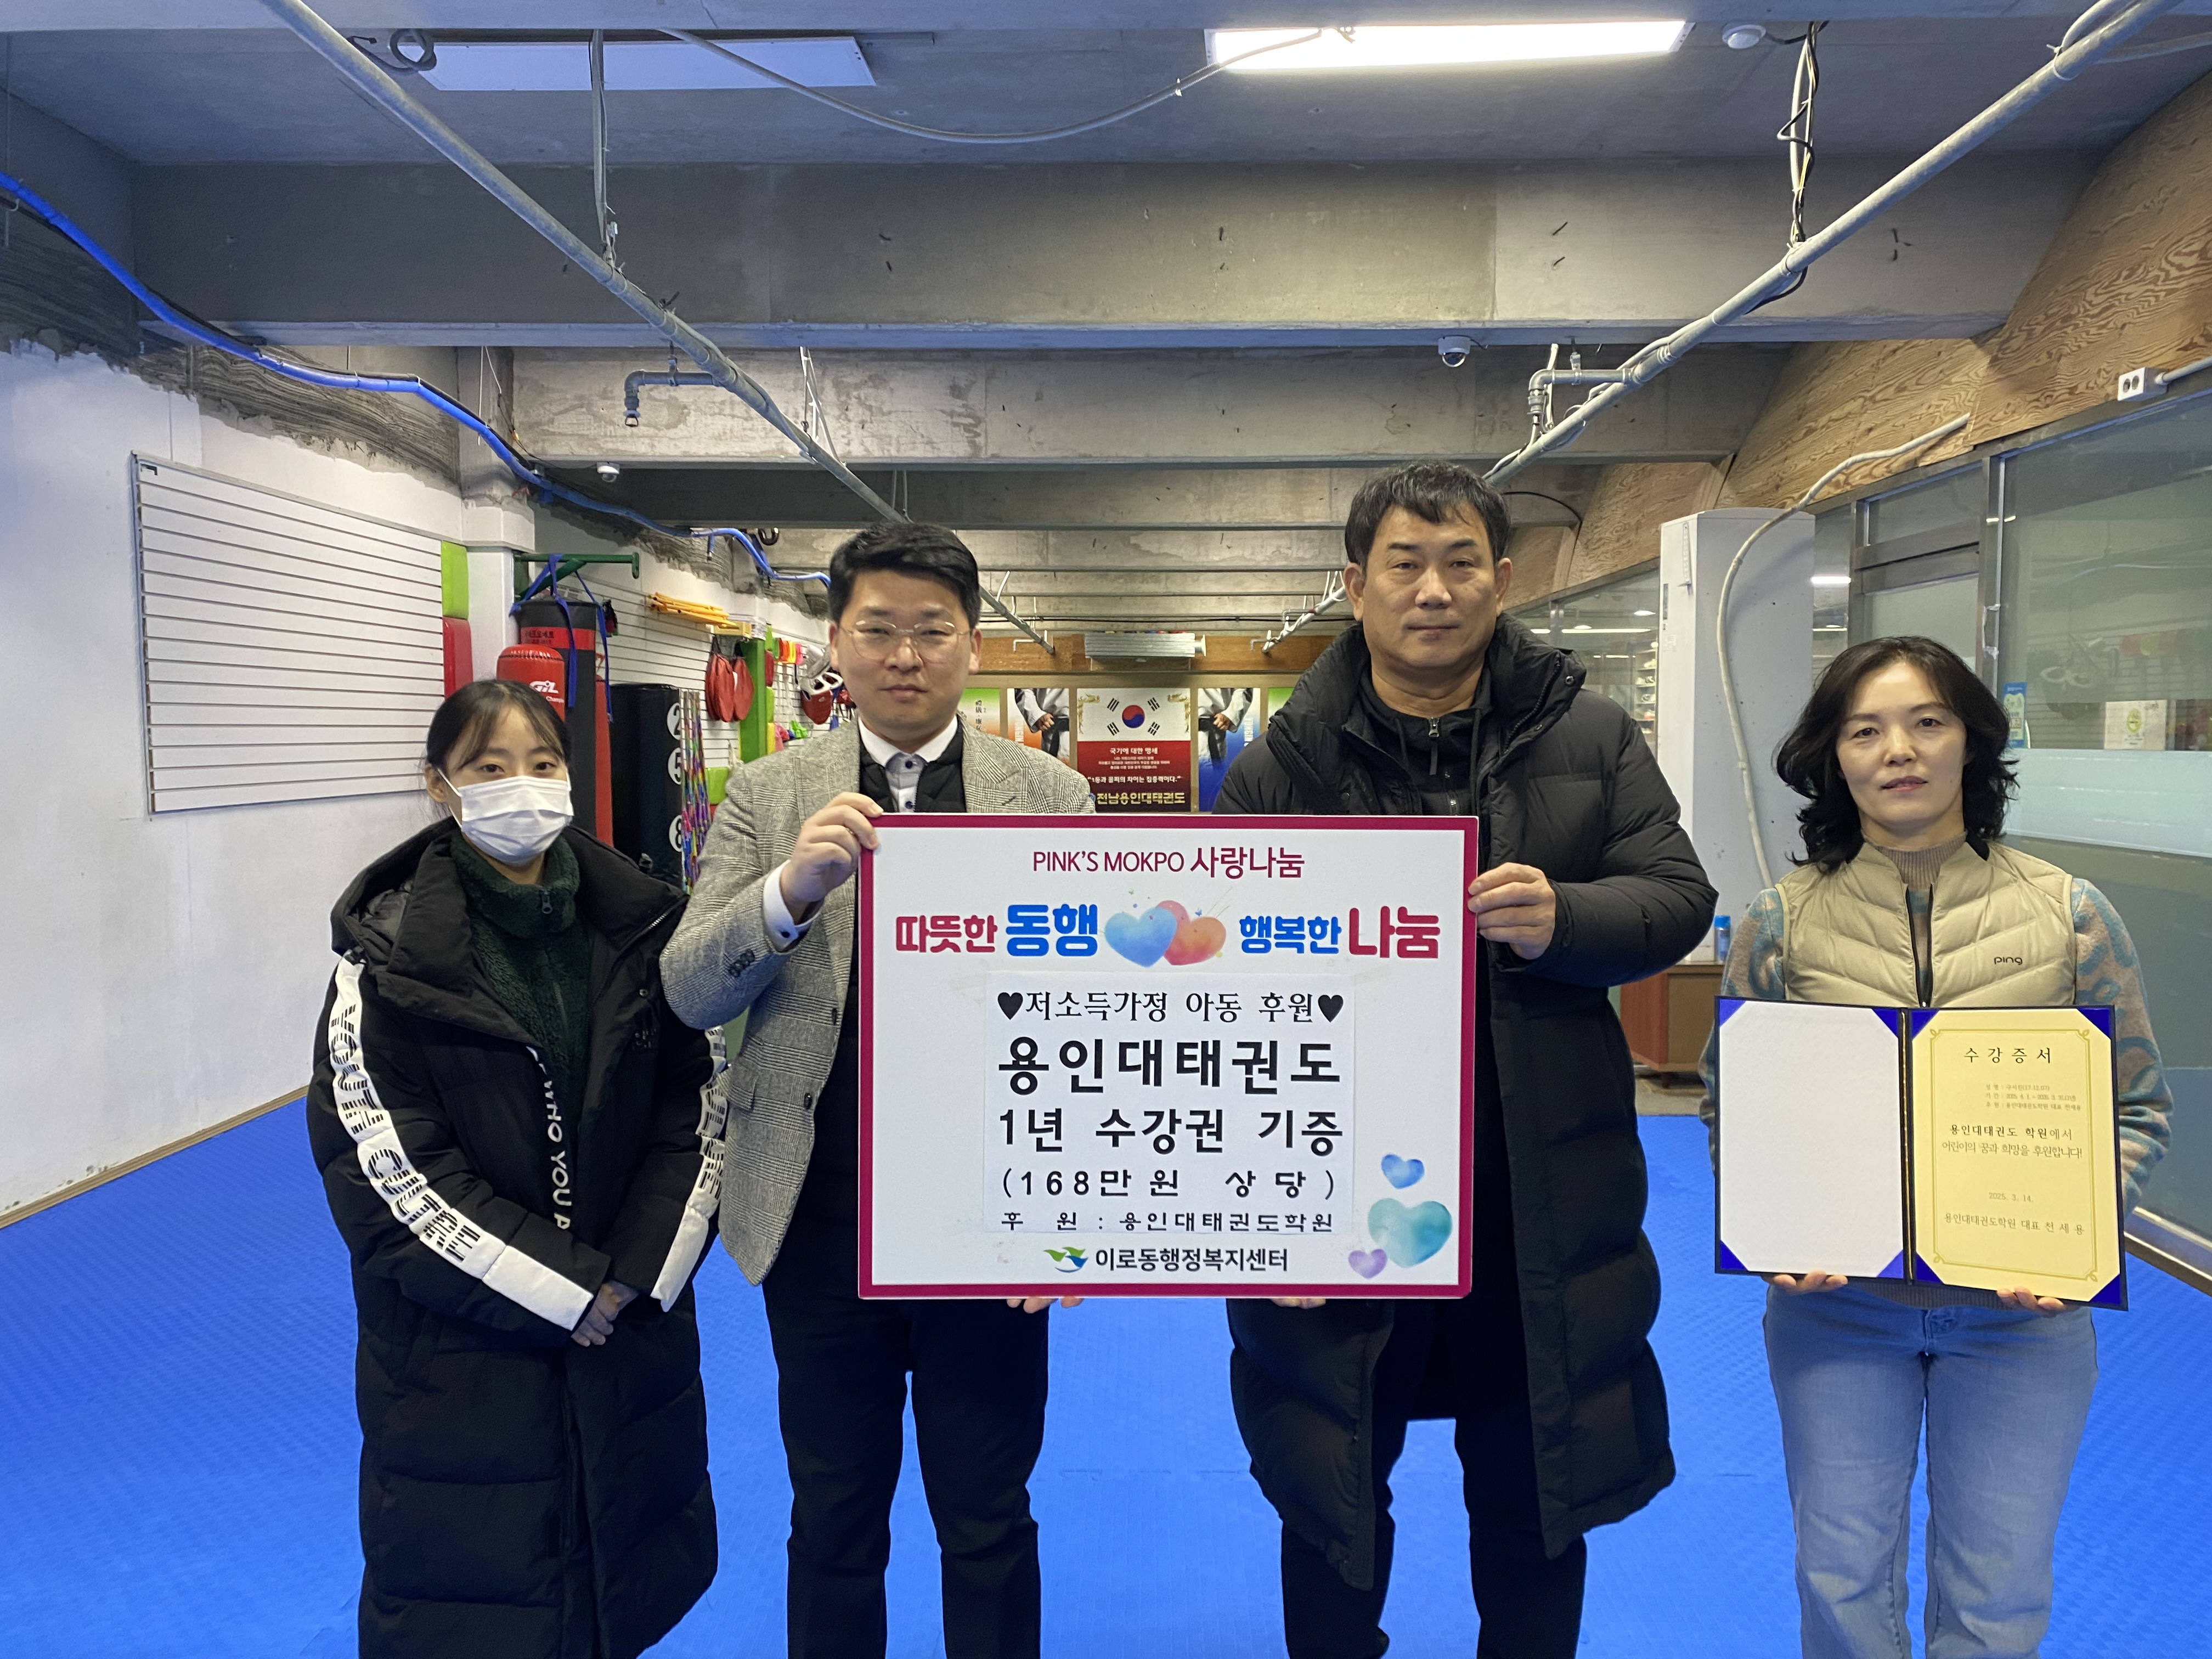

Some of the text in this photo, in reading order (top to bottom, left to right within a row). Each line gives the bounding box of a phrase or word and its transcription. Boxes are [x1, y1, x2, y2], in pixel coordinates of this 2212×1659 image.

[1097, 792, 1186, 805] 전남용인대태권도
[1034, 847, 1305, 879] PINK'S MOKPO 사랑나눔
[896, 904, 1441, 958] 따뜻한 동행 행복한 나눔
[1994, 956, 2023, 965] ping
[1026, 992, 1314, 1023] 저소득가정 아동 후원
[998, 1037, 1341, 1096] 용인대태권도
[999, 1109, 1344, 1156] 1년 수강권 기증
[1950, 1125, 2072, 1141] 용인대태권도 학원에서
[1942, 1141, 2082, 1159] 어린이의 꿈과 희망을 후원합니다!
[551, 1150, 572, 1206] YOU
[1119, 1212, 1333, 1233] 용인대태권도학원
[1944, 1212, 2016, 1229] 용인대태권도학원
[2021, 1220, 2040, 1230] 대표
[1096, 1248, 1288, 1272] 이로동행정복지센터
